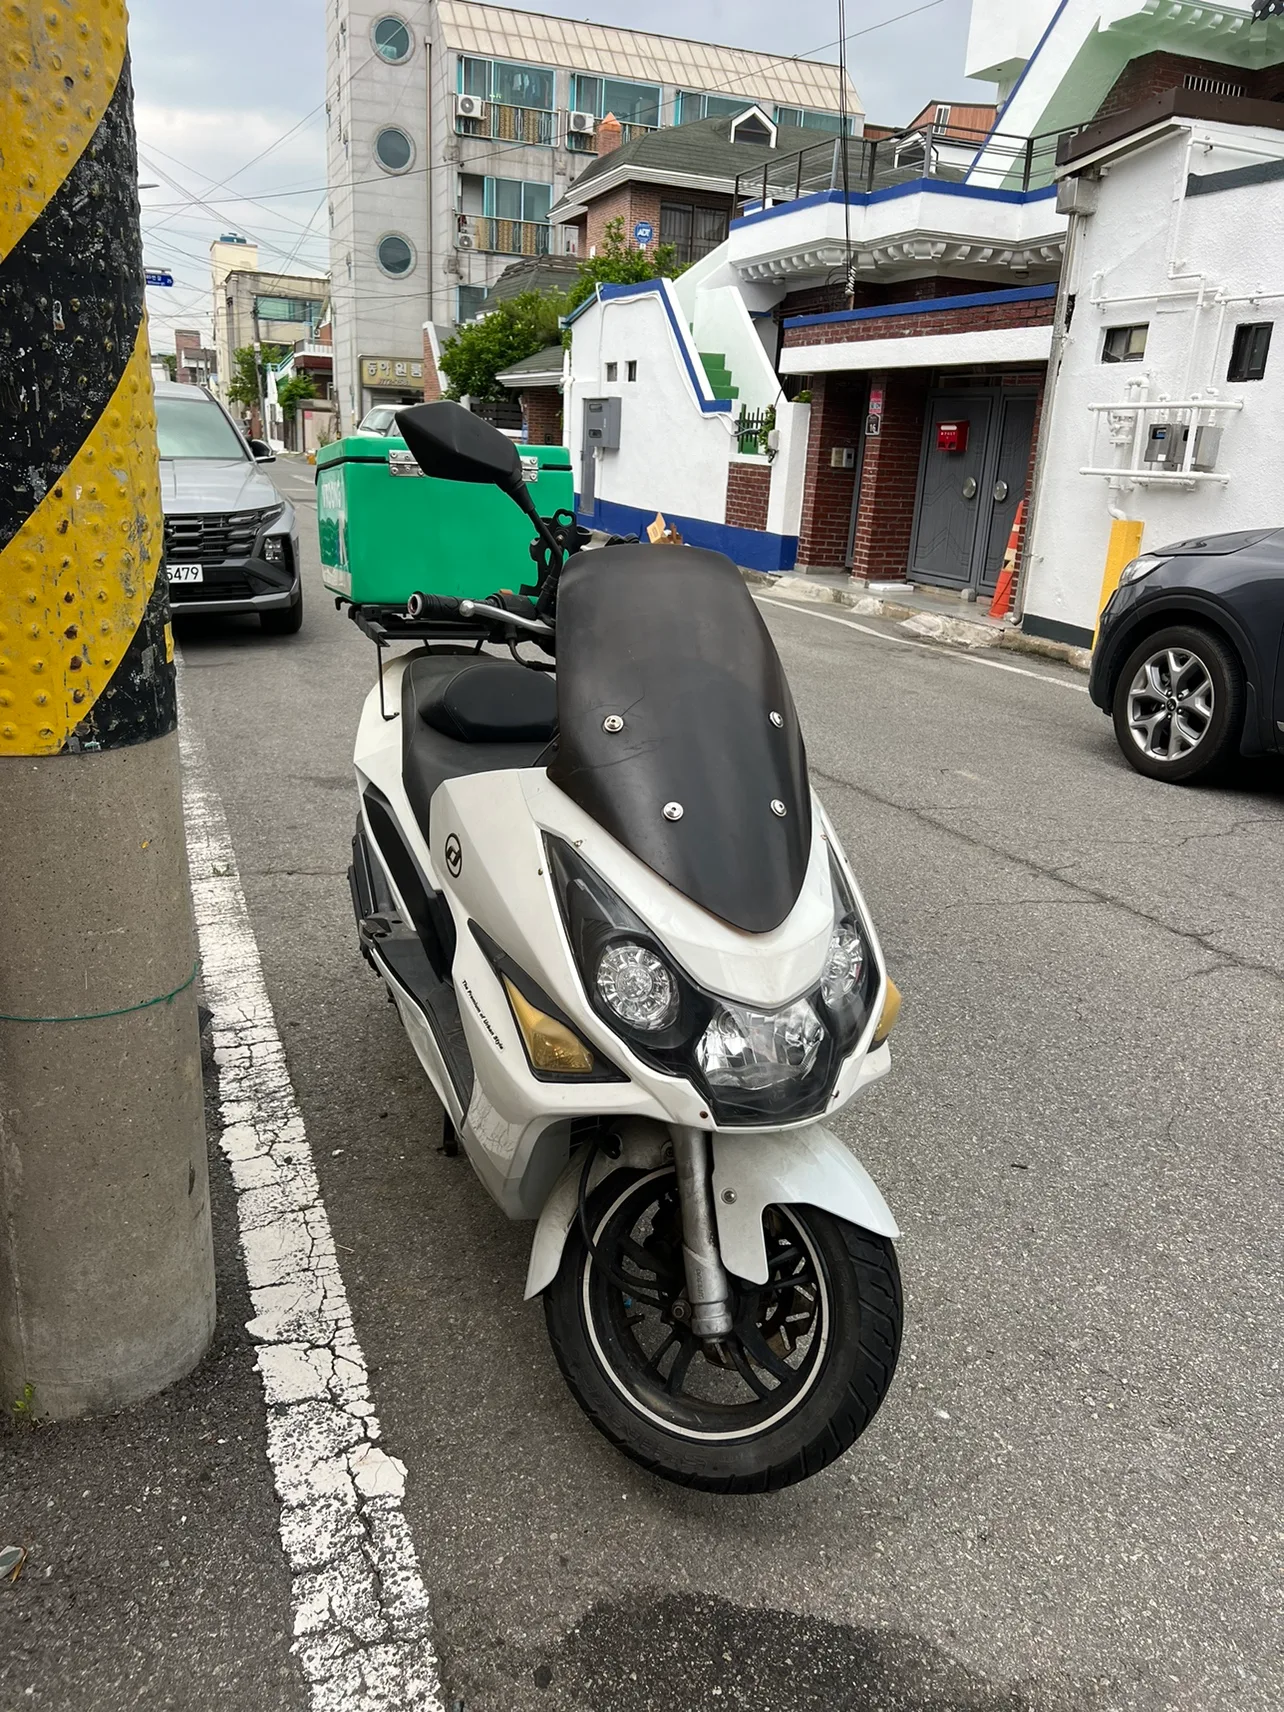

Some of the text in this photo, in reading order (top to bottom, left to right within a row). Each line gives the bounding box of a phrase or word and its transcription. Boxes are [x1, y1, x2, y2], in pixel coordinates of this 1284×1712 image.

[637, 228, 650, 236] ADT
[368, 361, 422, 379] 동아원룸
[166, 566, 199, 581] 5479
[467, 990, 481, 1013] Premium
[483, 1019, 494, 1036] Urban
[493, 1035, 504, 1050] Style
